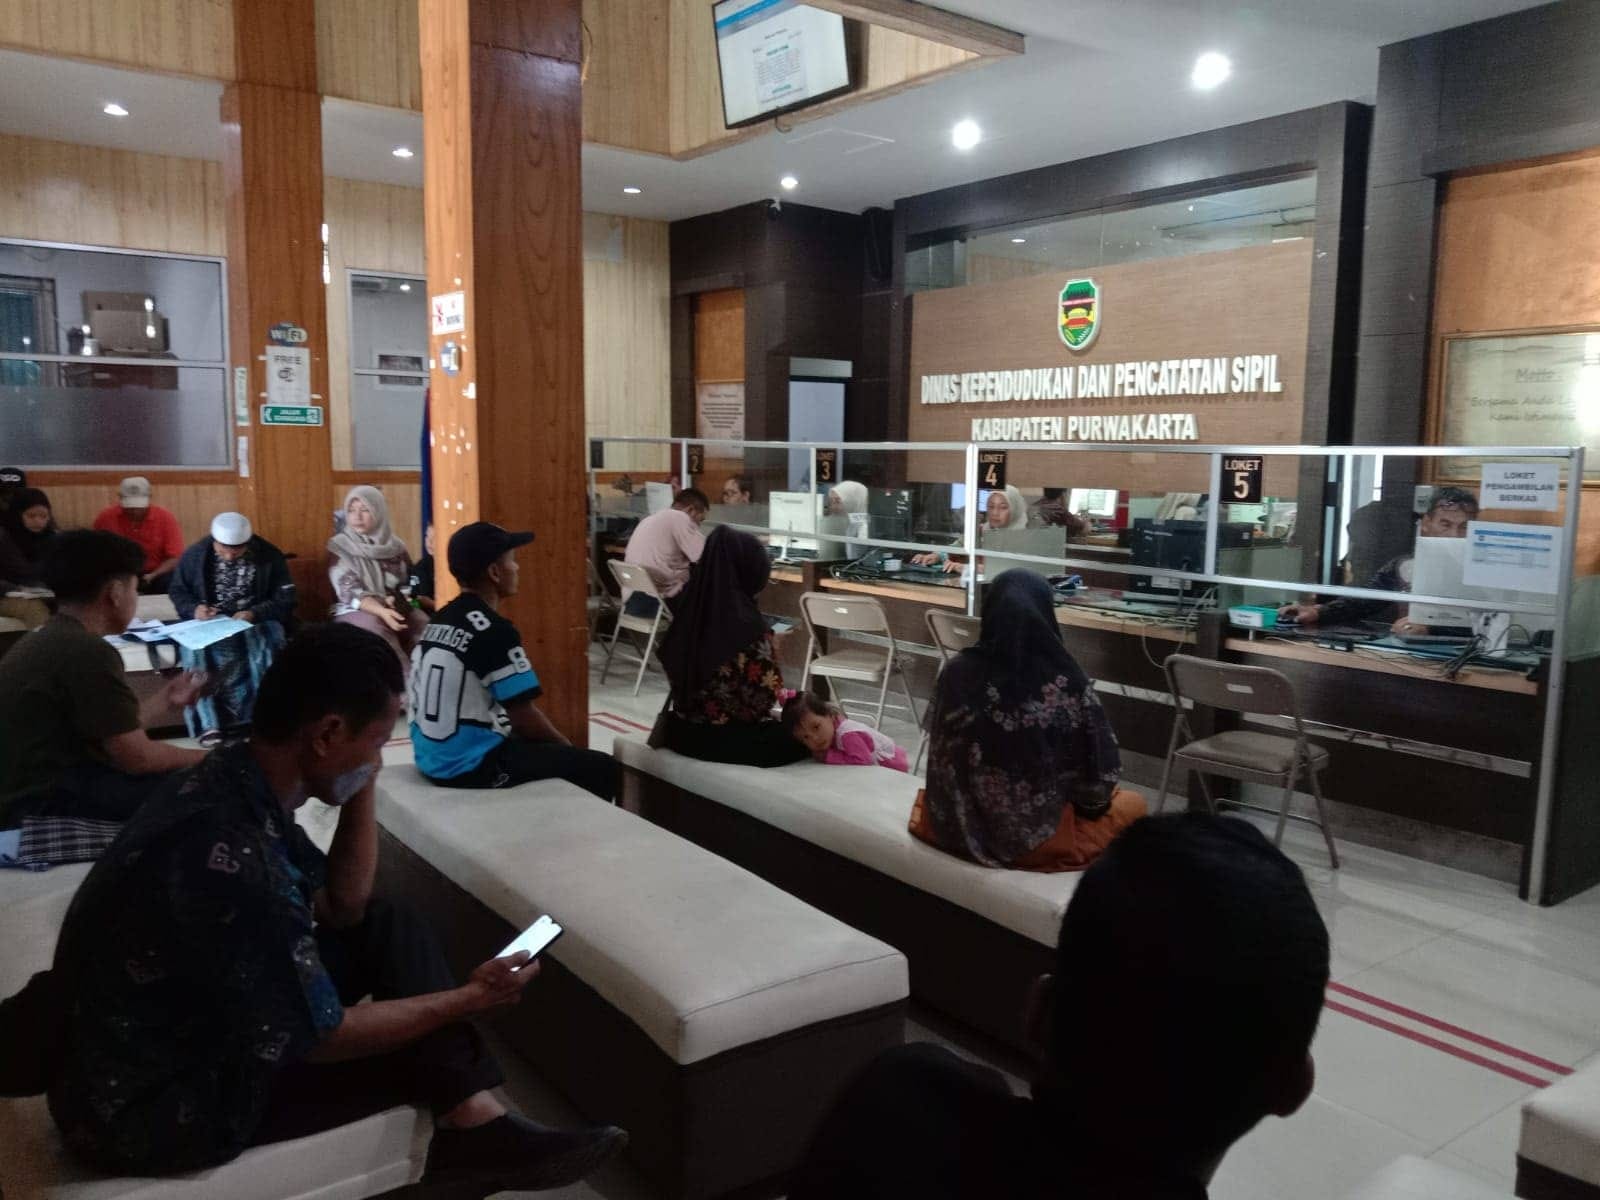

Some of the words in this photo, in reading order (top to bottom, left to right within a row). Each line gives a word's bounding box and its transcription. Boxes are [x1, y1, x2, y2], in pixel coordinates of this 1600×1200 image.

[921, 374, 961, 404] DINAS
[960, 367, 1075, 403] KEPENDUDUKAN
[1077, 364, 1114, 398] DAN
[1113, 357, 1228, 397] PENCATATAN
[1230, 354, 1282, 393] SIPIL
[971, 416, 1064, 441] KABUPATEN
[1067, 413, 1199, 441] PURWAKARTA
[690, 456, 699, 472] 2
[821, 460, 831, 480] 3
[1224, 459, 1261, 471] LOKET
[985, 464, 998, 486] 4
[1233, 471, 1249, 499] 5
[1503, 472, 1536, 480] LOKET
[1485, 483, 1554, 491] PENGAMBILAN
[1499, 494, 1537, 502] BERKAS
[466, 610, 492, 631] 8
[507, 646, 532, 674] 8
